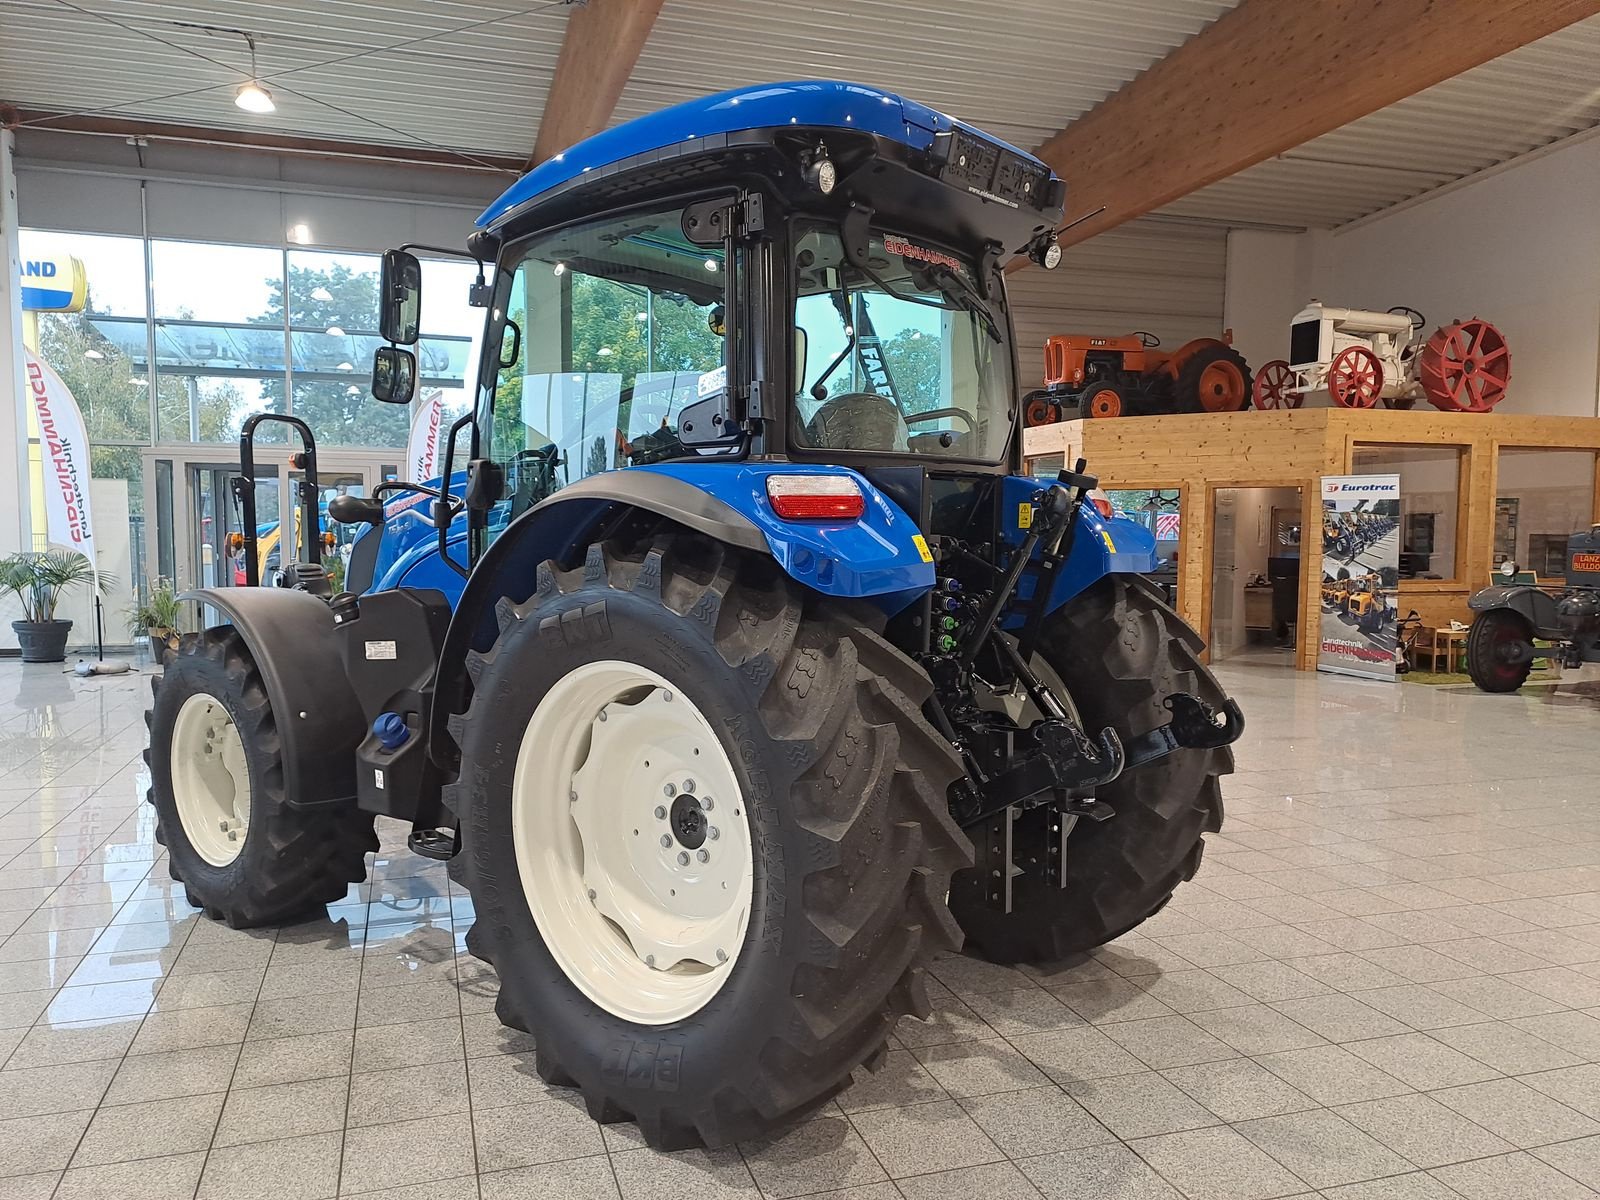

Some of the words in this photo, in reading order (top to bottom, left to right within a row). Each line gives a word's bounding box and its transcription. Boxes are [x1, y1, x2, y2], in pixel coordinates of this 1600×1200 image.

[860, 347, 897, 406] FARE
[1341, 483, 1397, 492] Eurotrac
[1580, 555, 1600, 563] LANZ
[1322, 636, 1363, 649] Landtechnik
[1322, 643, 1393, 662] EIDENH
